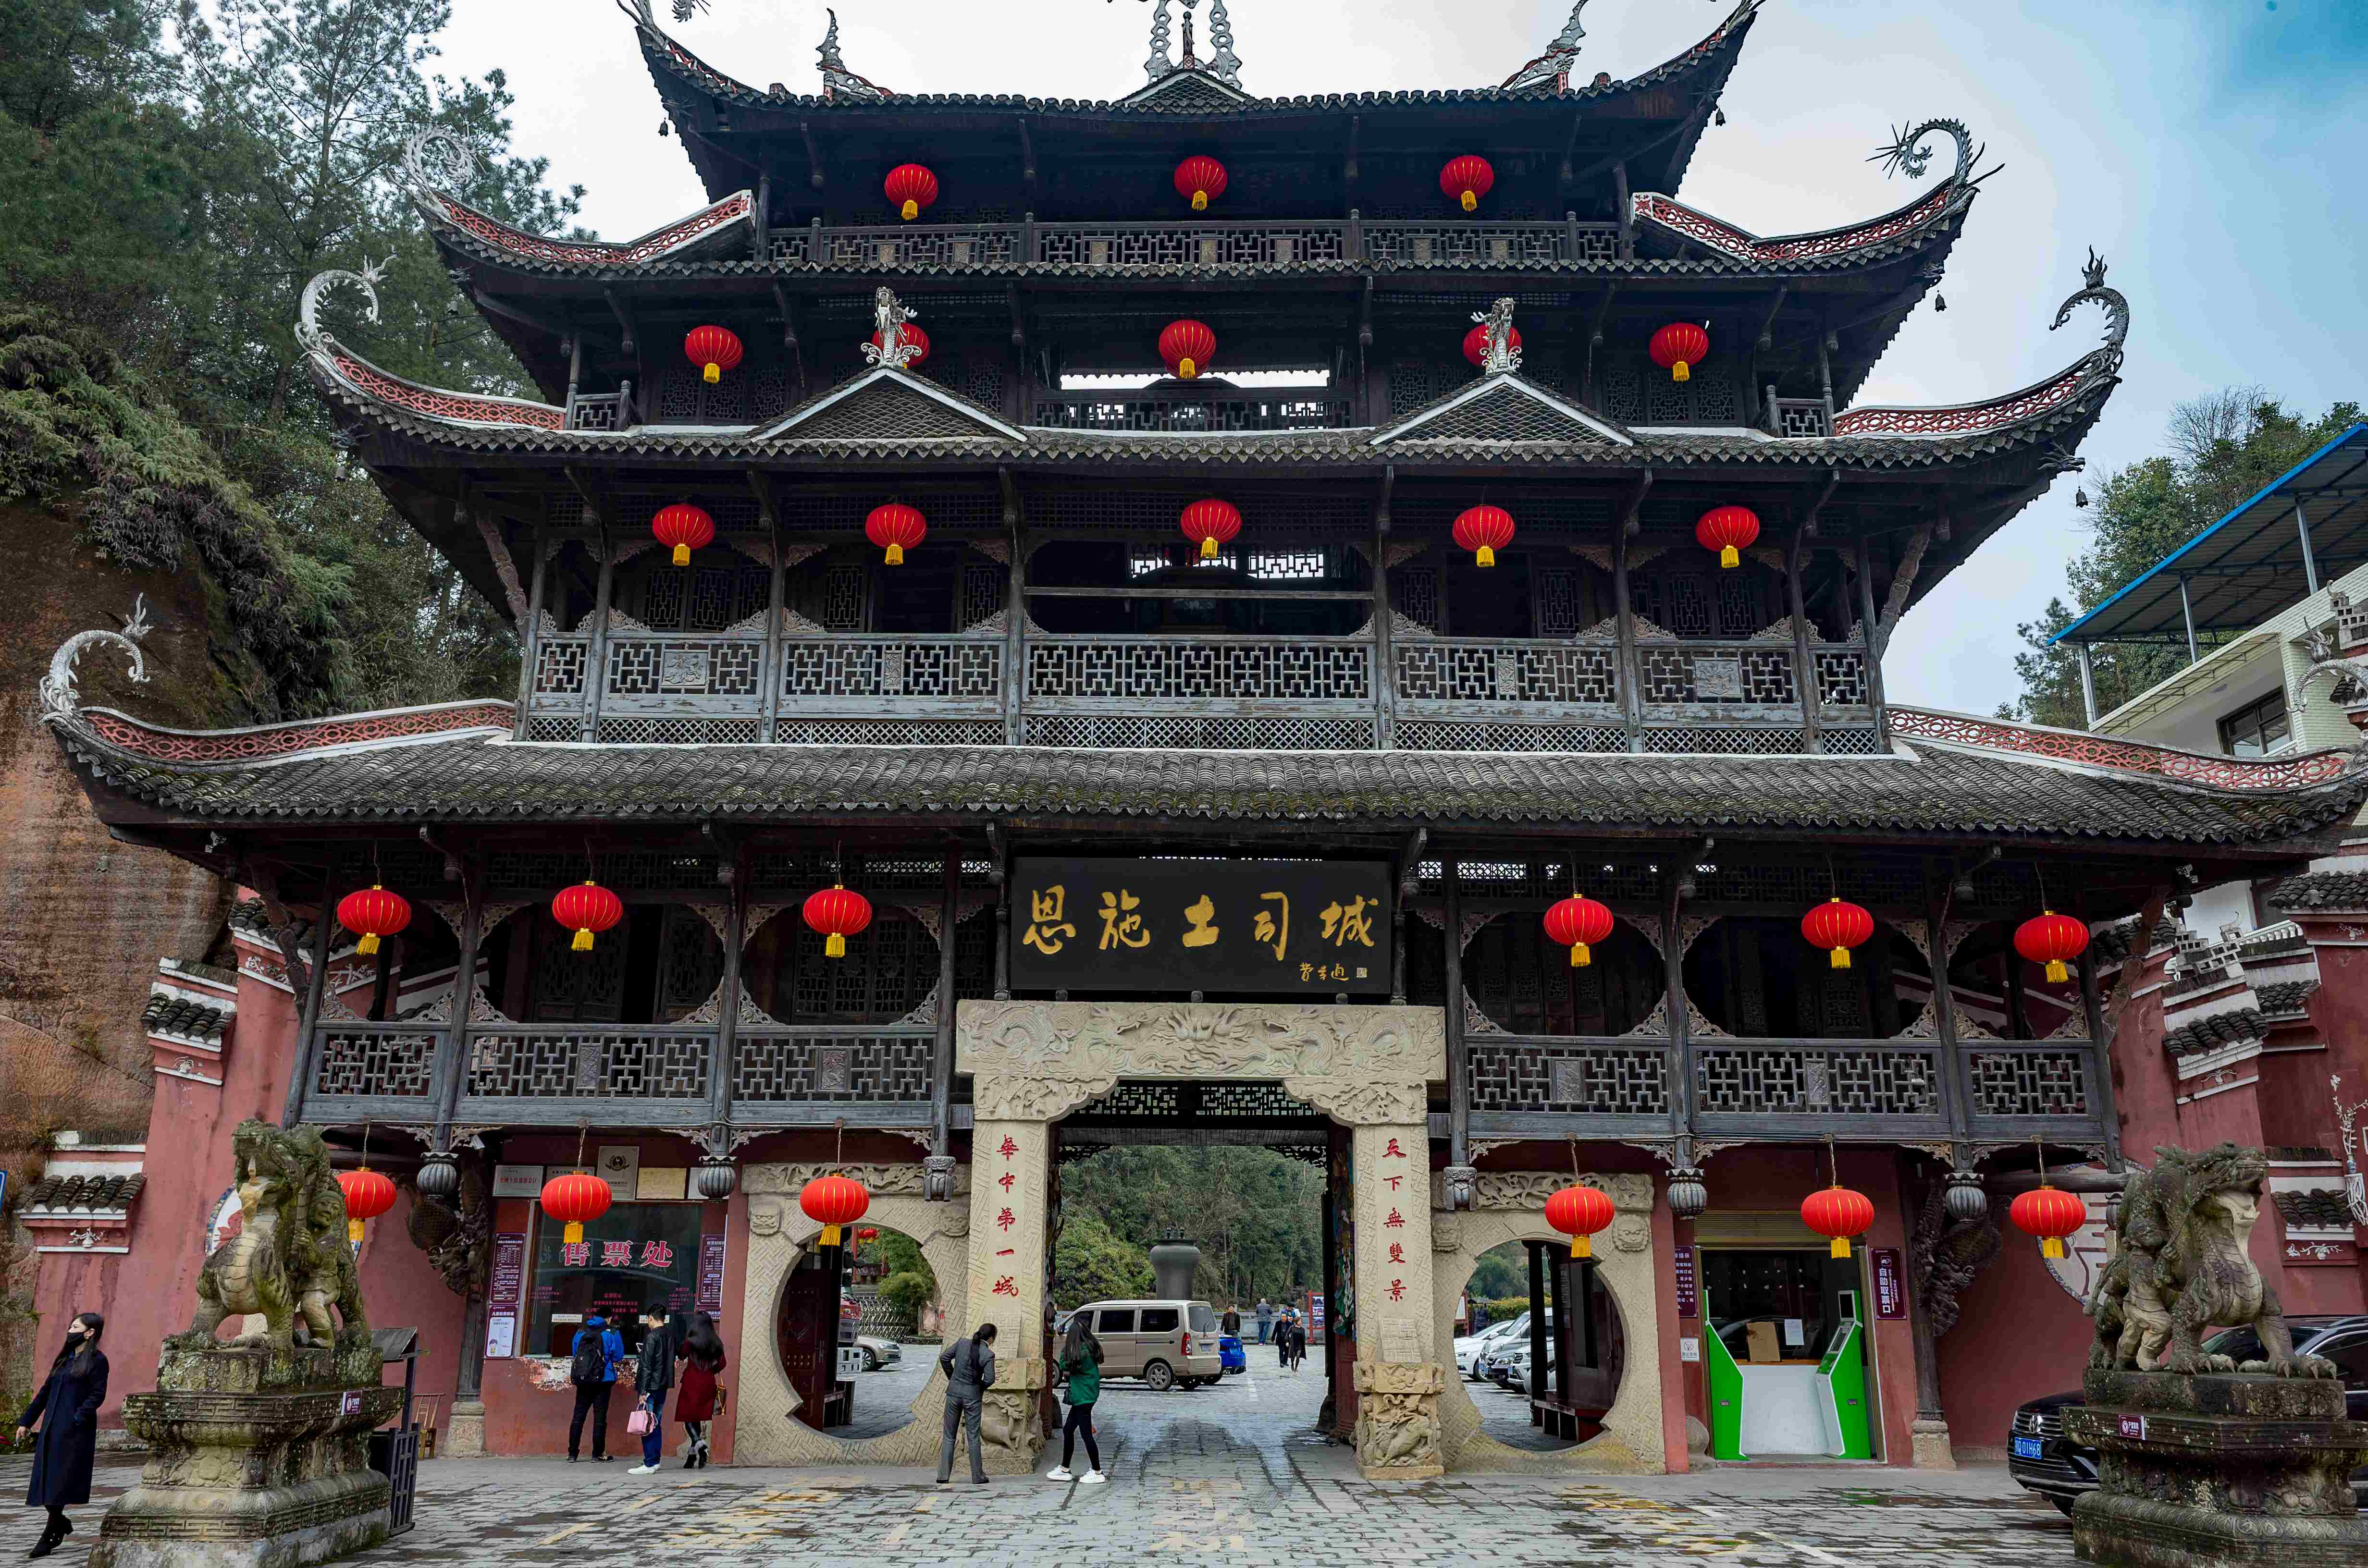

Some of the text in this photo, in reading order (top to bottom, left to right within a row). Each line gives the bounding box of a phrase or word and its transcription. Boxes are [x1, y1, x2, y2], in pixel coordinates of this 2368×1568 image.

[1023, 884, 1378, 961] 恩施土司城
[1382, 1138, 1407, 1302] 天下無雙景
[561, 1240, 673, 1267] 售票处
[1879, 1268, 1891, 1313] 自助取票口
